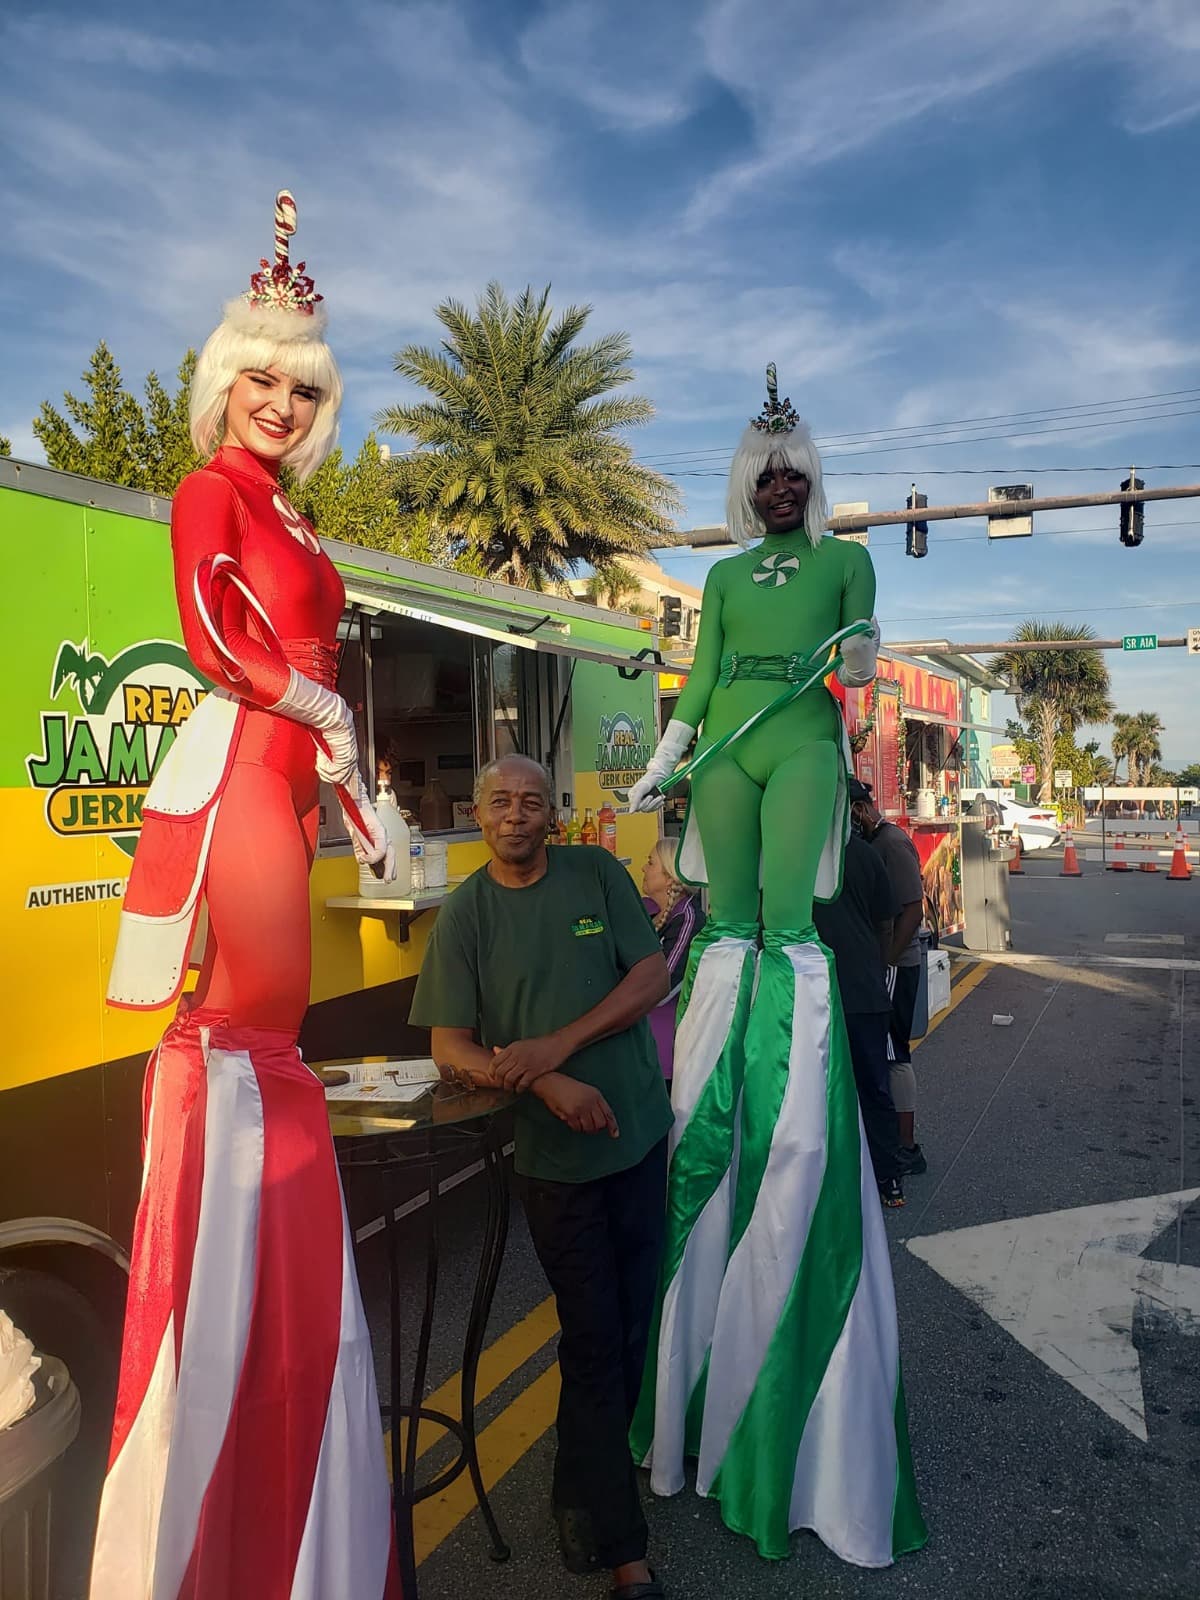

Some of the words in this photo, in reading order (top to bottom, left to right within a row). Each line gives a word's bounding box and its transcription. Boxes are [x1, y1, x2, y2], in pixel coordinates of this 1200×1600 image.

[1126, 637, 1137, 649] SR
[614, 729, 637, 746] REAL
[595, 743, 651, 771] JAMAICAN
[602, 773, 620, 786] JERK
[622, 771, 647, 785] CENT
[62, 793, 144, 827] JERK
[28, 882, 121, 908] AUTHENTIC
